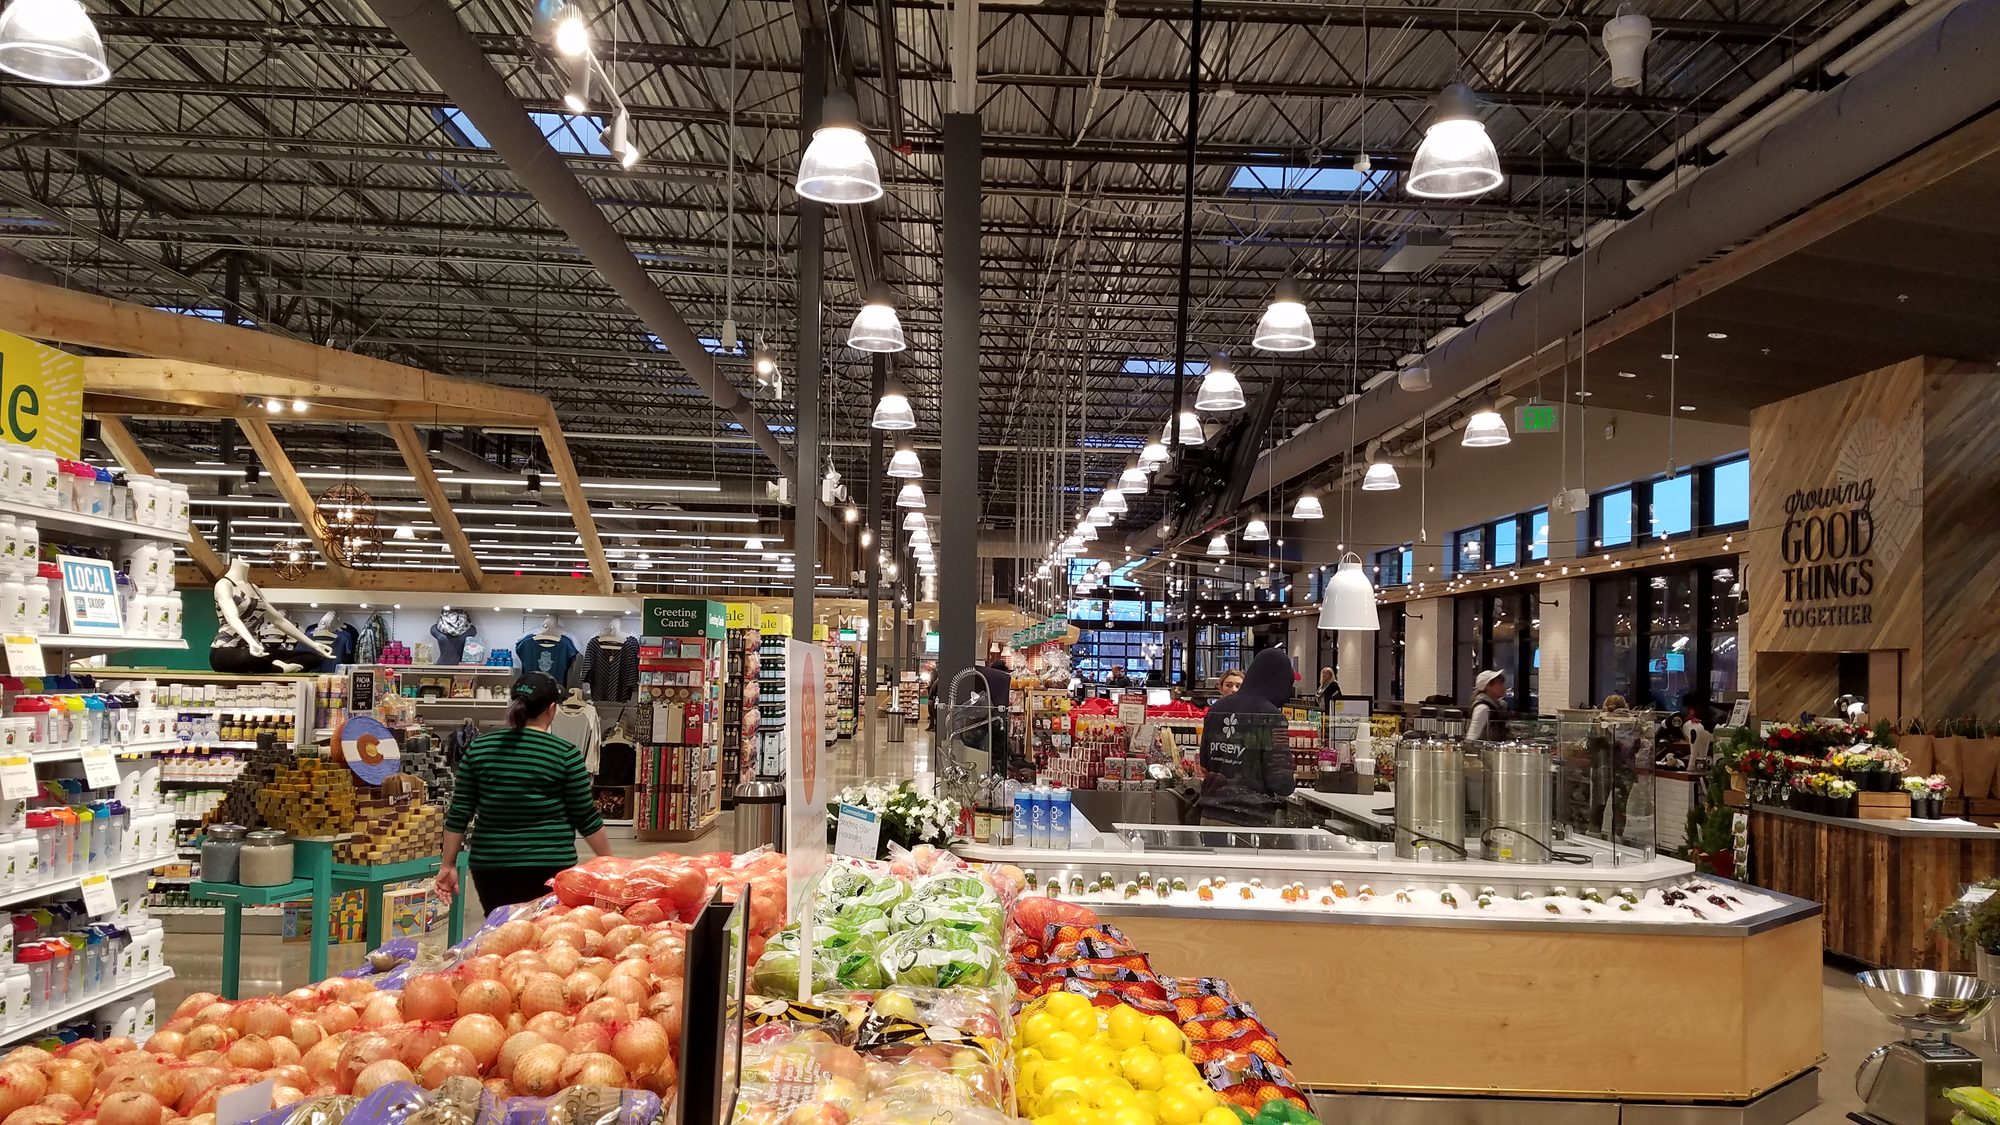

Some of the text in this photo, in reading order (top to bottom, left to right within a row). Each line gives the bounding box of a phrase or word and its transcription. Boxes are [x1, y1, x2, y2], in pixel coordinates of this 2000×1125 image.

[1784, 477, 1876, 531] growing
[1781, 509, 1874, 565] GOOD
[68, 564, 110, 593] LOCAL
[1782, 559, 1874, 602] THINGS
[653, 607, 697, 619] Greeting
[660, 618, 690, 628] Cards
[726, 609, 745, 622] ale
[838, 614, 894, 631] MELS
[1783, 603, 1873, 628] TOGETHER
[760, 620, 777, 629] ale
